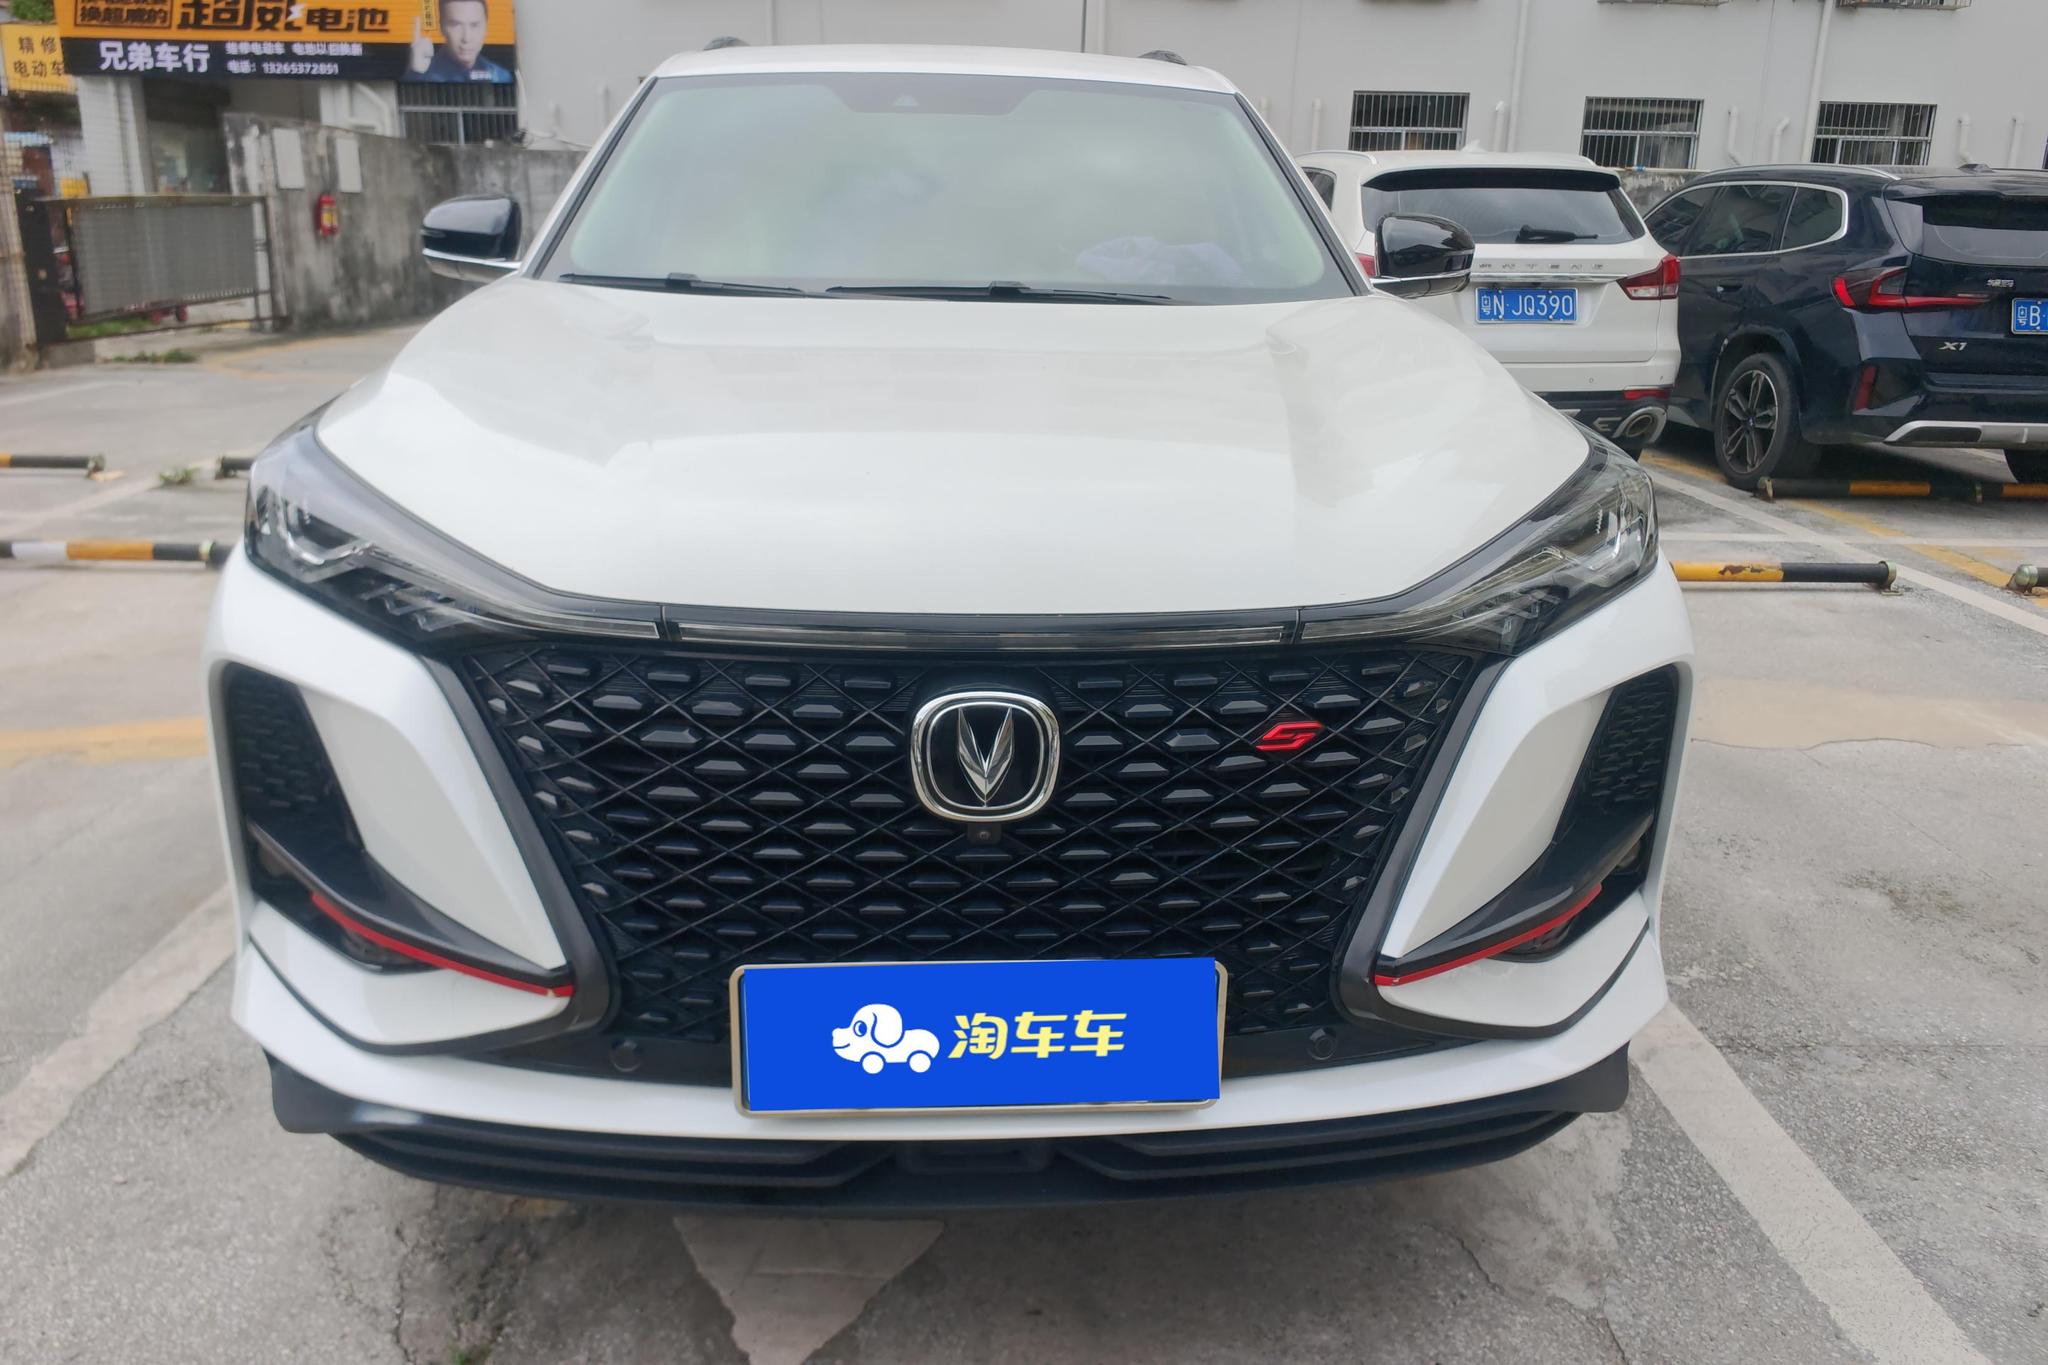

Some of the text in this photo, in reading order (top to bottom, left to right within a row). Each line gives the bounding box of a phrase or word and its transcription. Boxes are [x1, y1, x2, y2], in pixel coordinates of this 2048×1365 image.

[99, 41, 211, 73] 兄弟车行
[1939, 341, 1967, 351] X1
